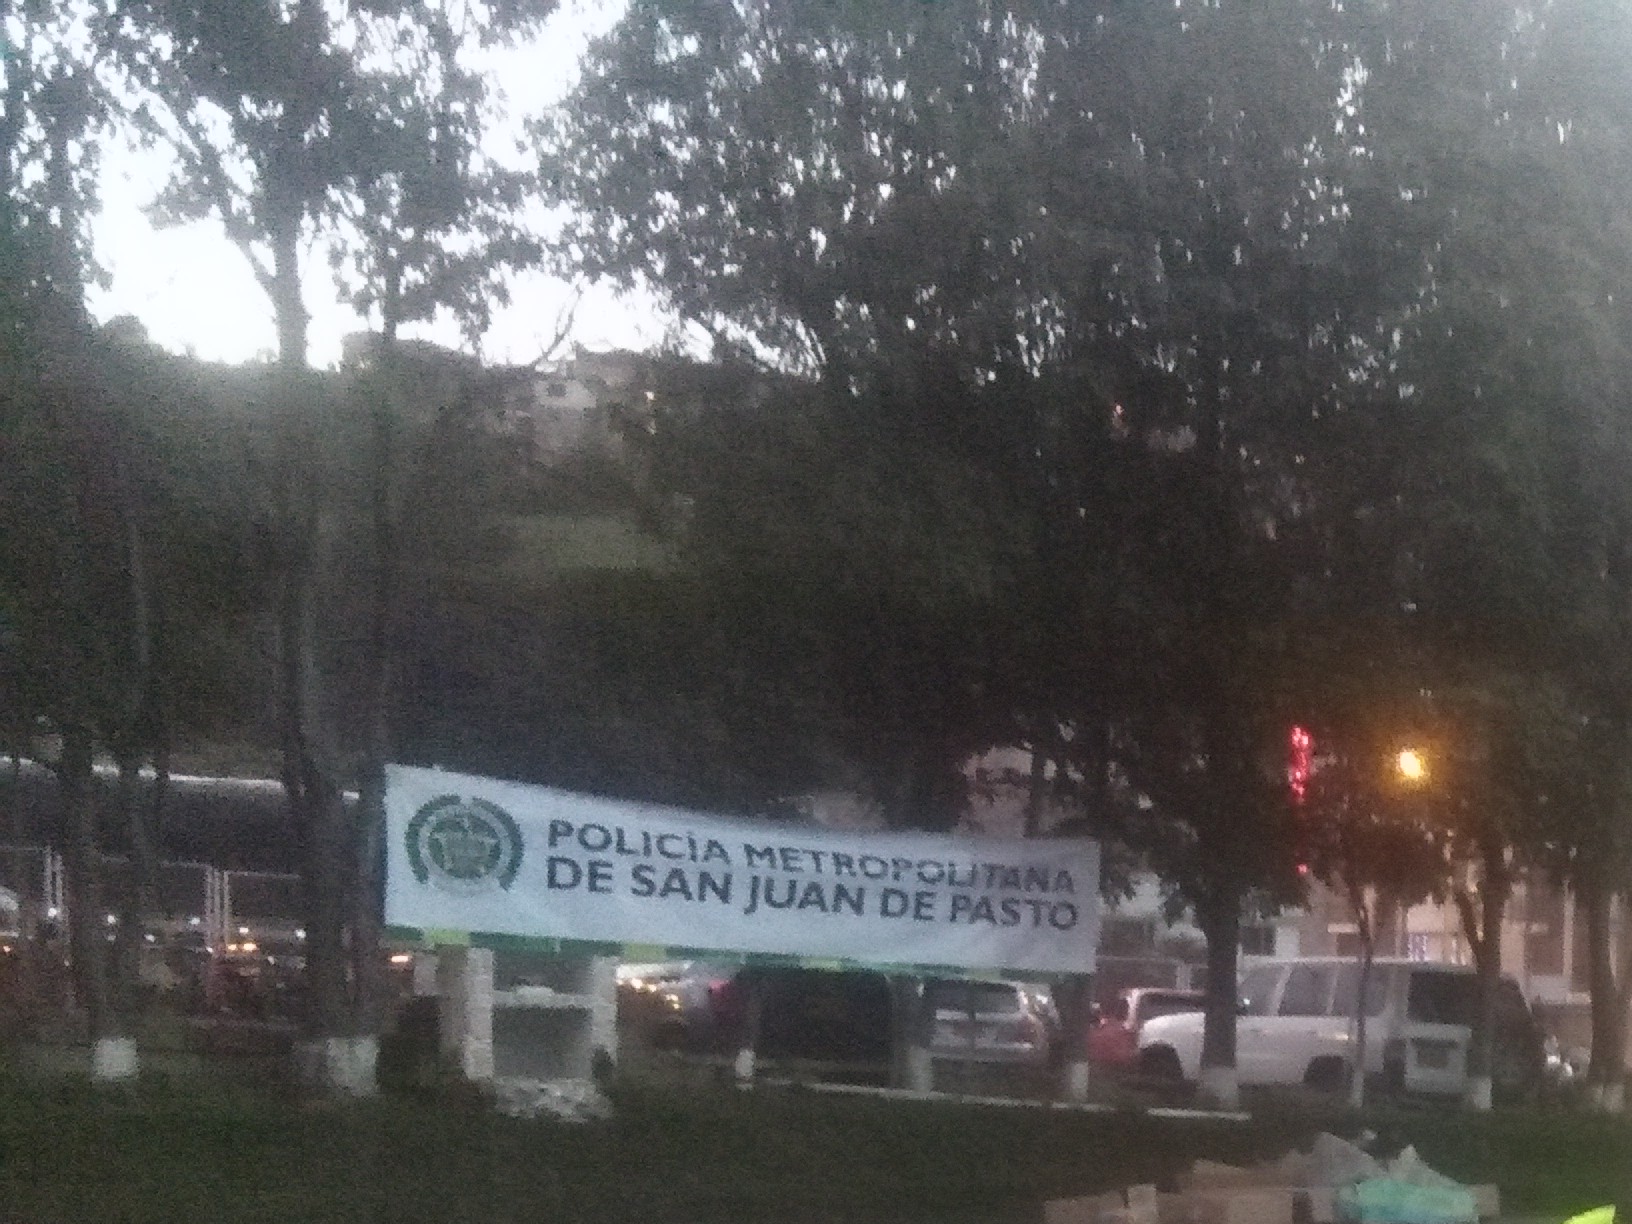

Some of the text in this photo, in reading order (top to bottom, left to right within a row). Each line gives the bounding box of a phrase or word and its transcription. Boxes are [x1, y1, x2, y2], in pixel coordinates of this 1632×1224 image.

[547, 856, 1080, 931] DE SAN JUAN DE PASTO
[744, 843, 1075, 894] METROPOLITANA
